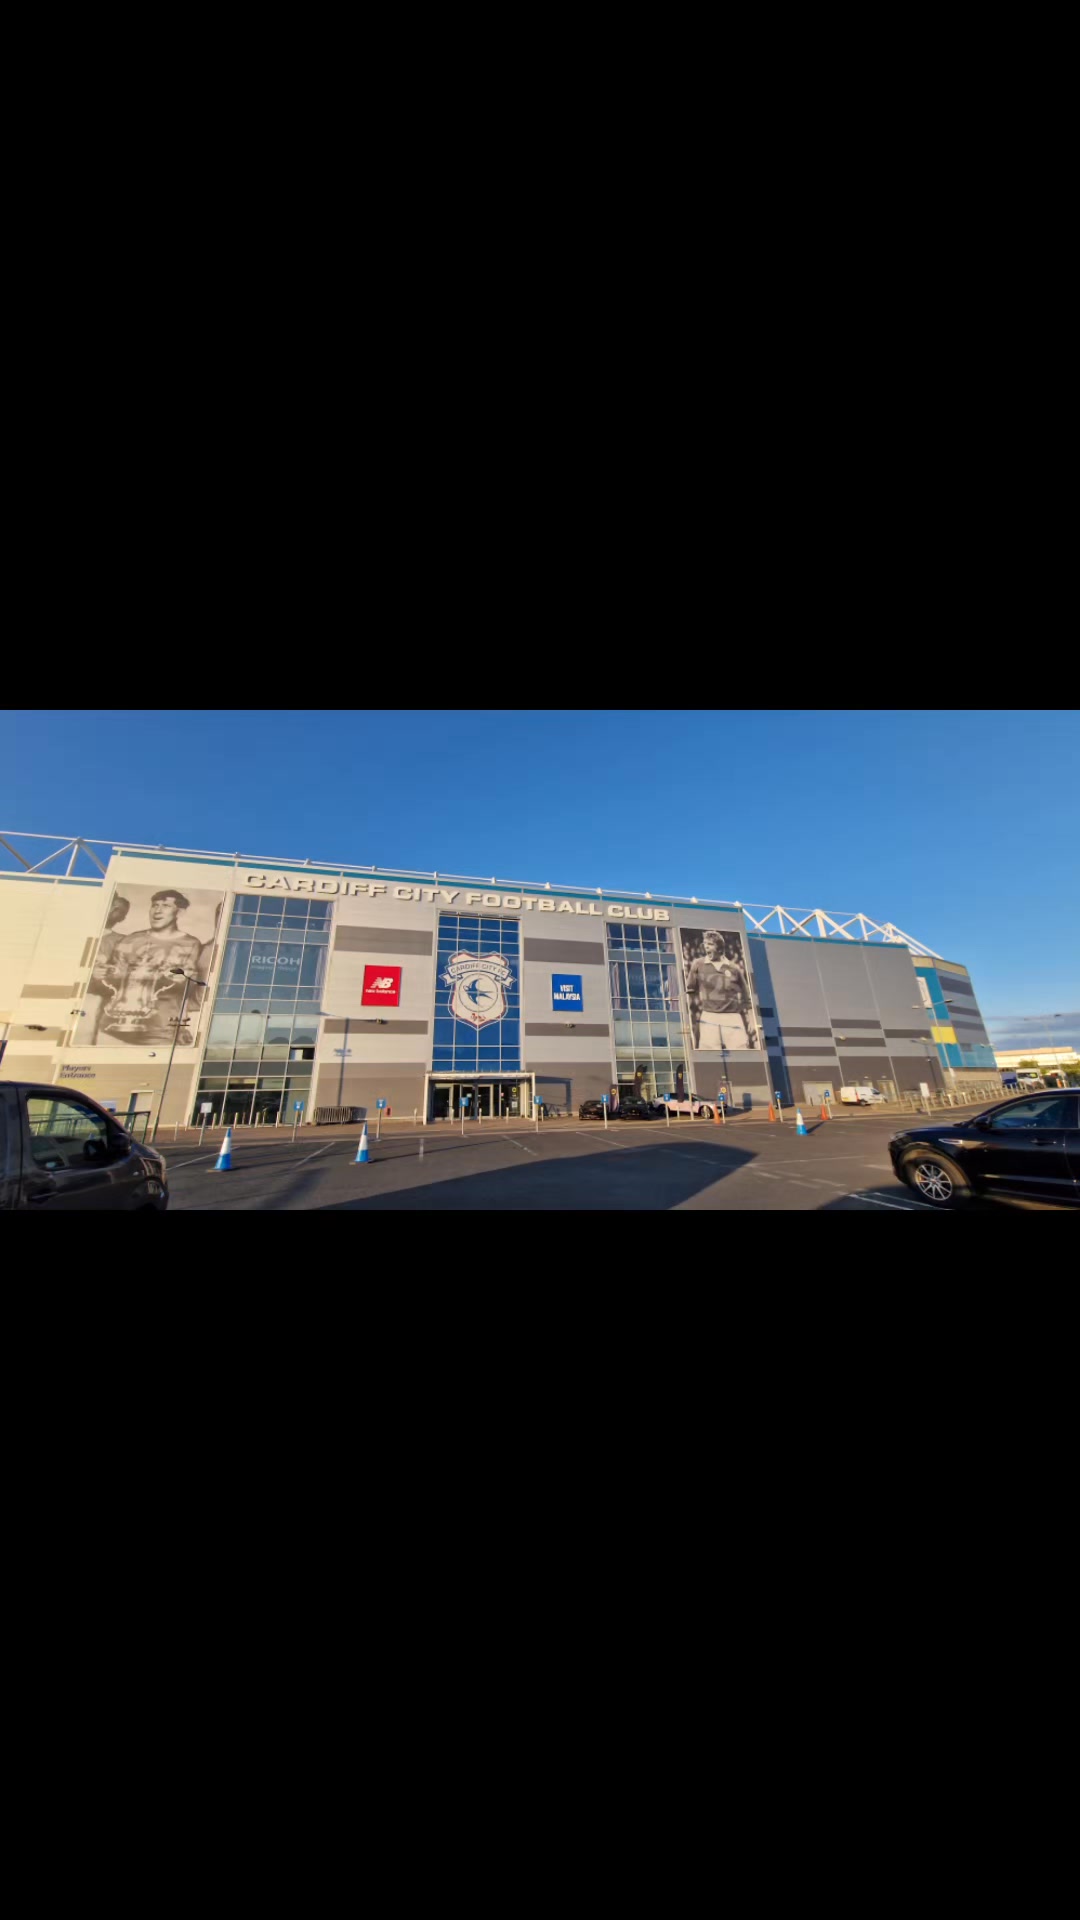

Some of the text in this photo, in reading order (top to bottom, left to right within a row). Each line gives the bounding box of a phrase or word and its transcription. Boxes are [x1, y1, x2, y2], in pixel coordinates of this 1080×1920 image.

[244, 874, 670, 921] CARDIFF CITY FOOTBALL CLUB
[251, 955, 300, 965] RICOH
[450, 963, 479, 974] CARDIFF
[481, 963, 497, 971] CITY
[559, 984, 574, 992] VISIT
[553, 992, 581, 1000] MALAYSIA
[62, 1064, 91, 1072] Players
